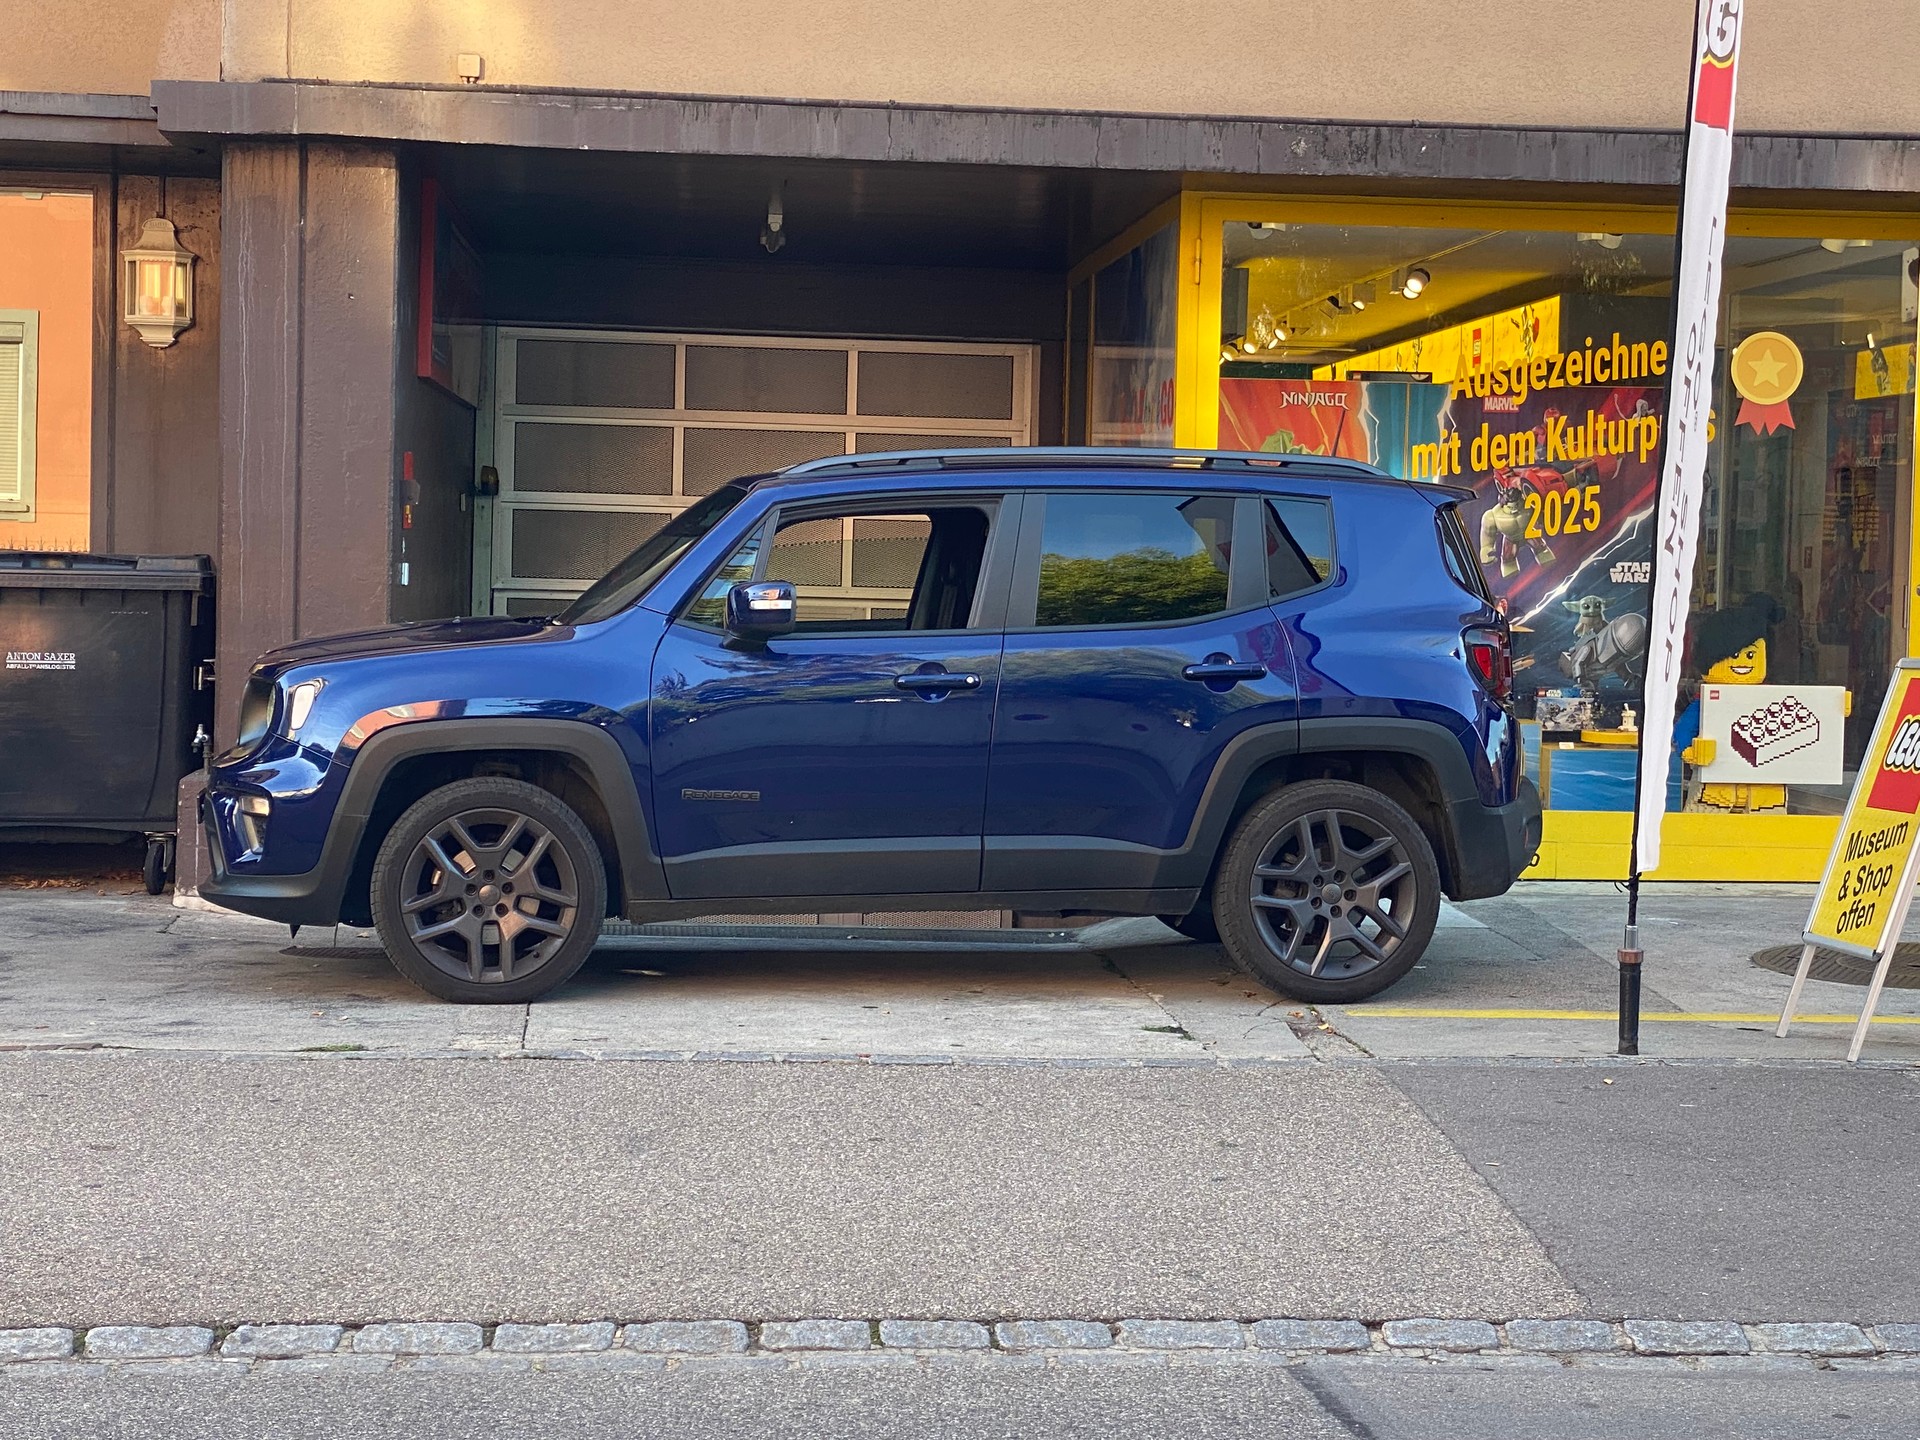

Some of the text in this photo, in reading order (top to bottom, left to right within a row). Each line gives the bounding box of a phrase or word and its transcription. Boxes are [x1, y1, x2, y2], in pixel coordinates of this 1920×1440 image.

[1450, 332, 1668, 405] Ausgezeichne
[1279, 391, 1350, 411] NINJAGO
[1411, 428, 1461, 480] mit
[1470, 422, 1536, 473] dem
[1663, 322, 1696, 556] OFFEN
[1523, 485, 1601, 540] 2025
[1610, 561, 1651, 573] STAR
[1664, 492, 1689, 683] SHOP
[6, 651, 76, 661] ANTON SAXER
[682, 788, 760, 801] RENEGADE
[1843, 821, 1909, 864] Museum
[1837, 863, 1893, 902] & Shop
[1836, 899, 1876, 935] offen
